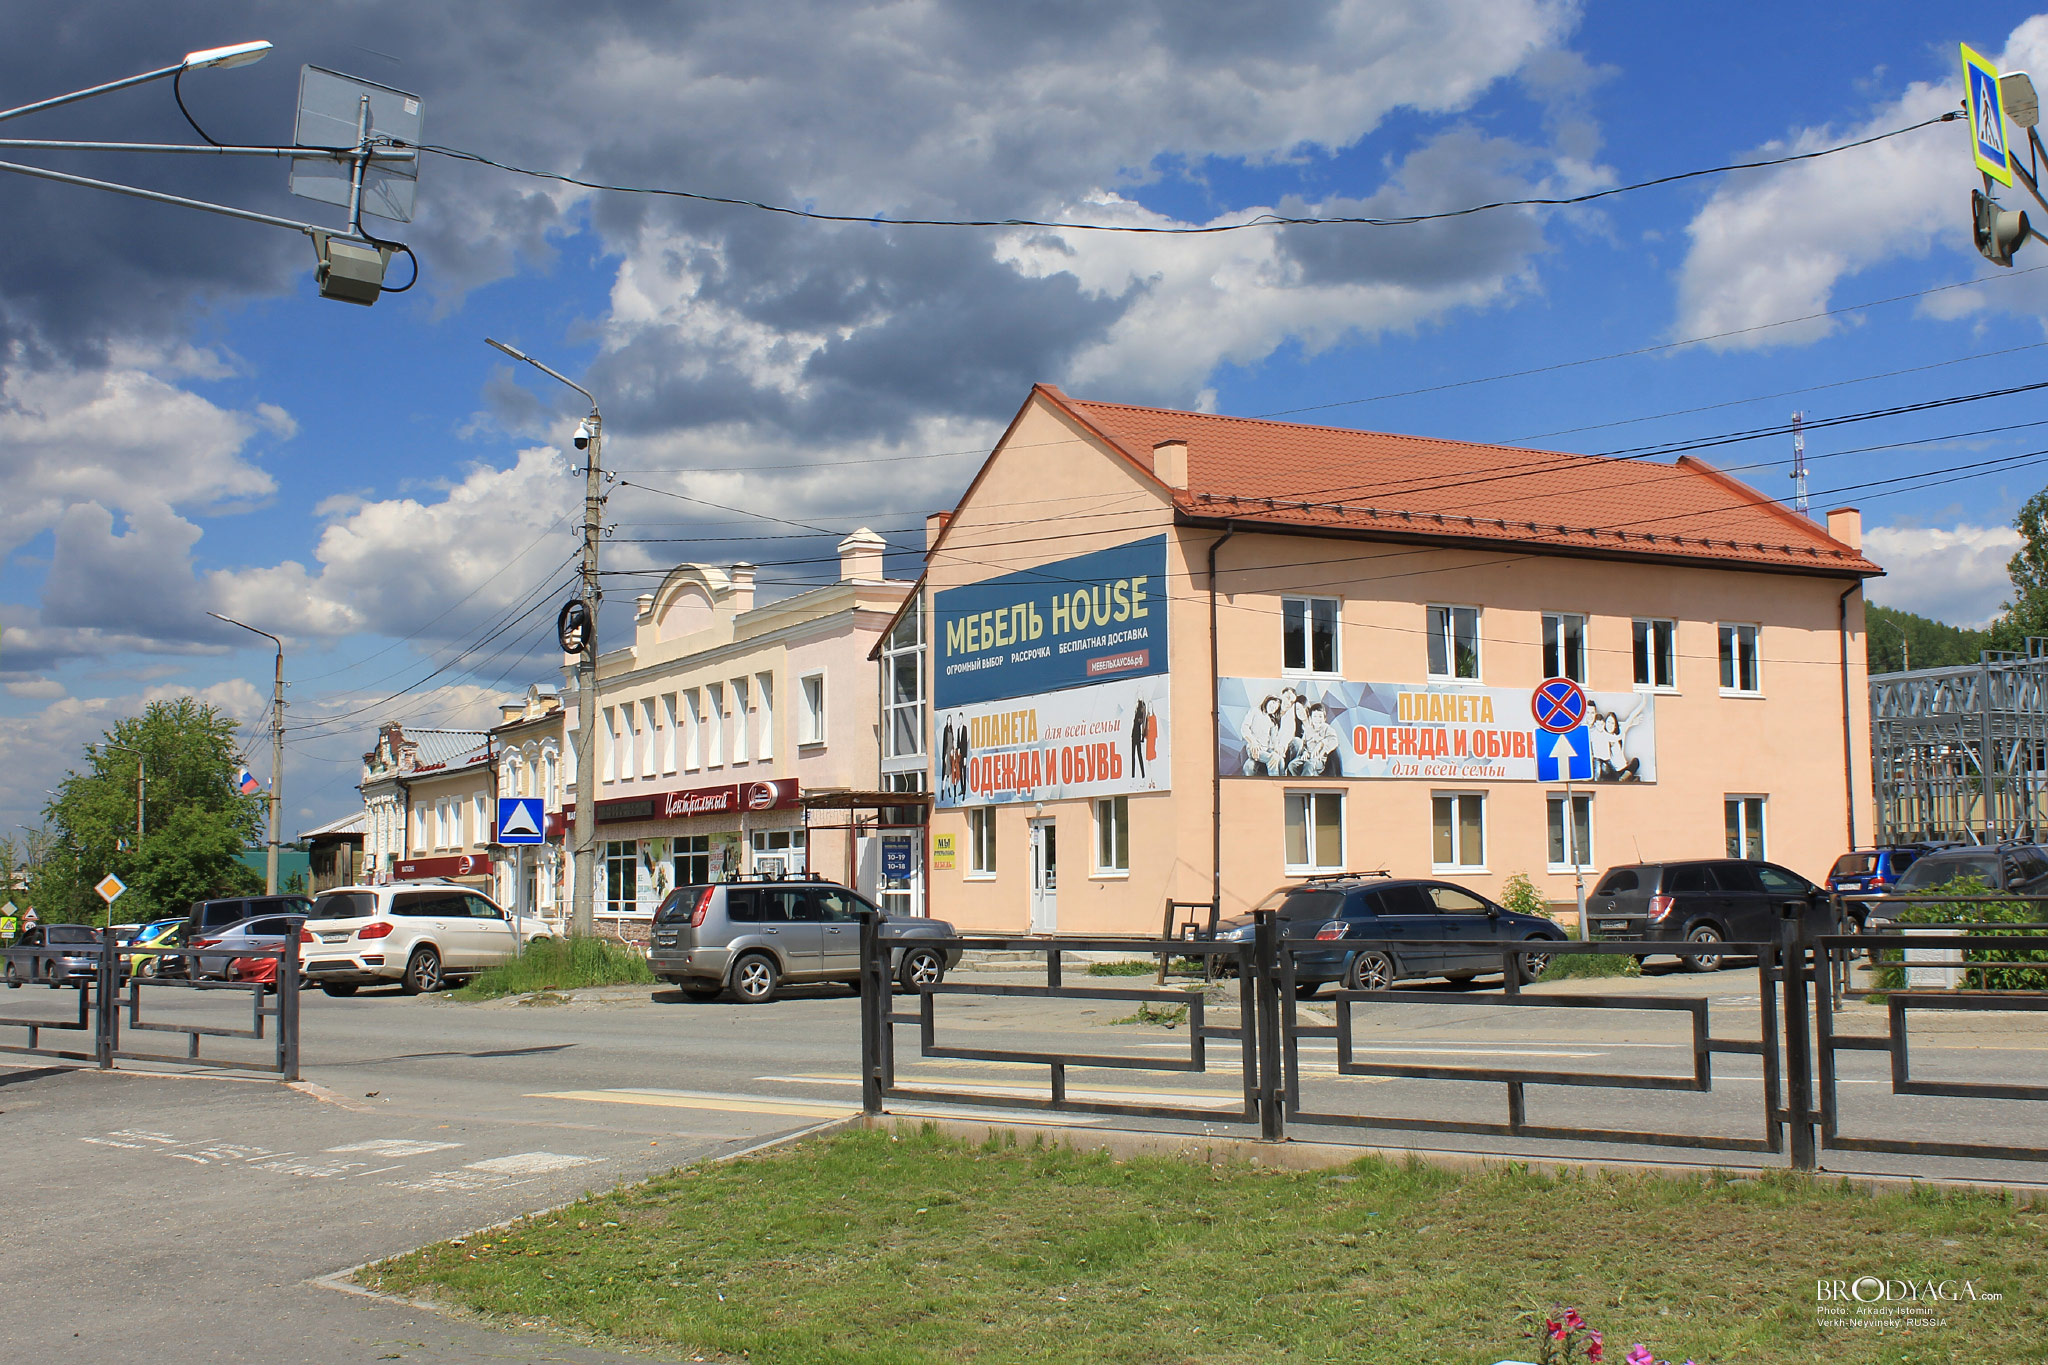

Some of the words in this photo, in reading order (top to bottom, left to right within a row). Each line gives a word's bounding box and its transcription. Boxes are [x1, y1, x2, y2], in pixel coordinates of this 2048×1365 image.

[946, 600, 1044, 657] МЕБЕЛЬ
[1052, 575, 1149, 635] HOUSE
[1059, 635, 1106, 654] БЕСПЛАТНАЯ
[1107, 627, 1149, 647] ДОСТАВКА
[946, 657, 981, 676] ОГРОМНЫЙ
[982, 655, 1004, 670] ВЫБОР
[1011, 646, 1051, 663] РАССРОЧКА
[1091, 654, 1144, 672] МЕБЕЛЬХАУС66.рф
[1398, 693, 1495, 723] ПЛАНЕТА
[970, 708, 1038, 749] ПЛАНЕТА
[1044, 723, 1062, 741] для
[1064, 719, 1087, 737] всей
[1089, 718, 1121, 735] семьи
[1353, 726, 1449, 760] ОДЕЖДА
[1453, 729, 1467, 756] И
[970, 750, 1042, 797] ОДЕЖДА
[1045, 748, 1058, 787] И
[1062, 742, 1122, 784] ОБУВЬ
[1392, 760, 1419, 776] для
[1424, 761, 1457, 776] всей
[1462, 765, 1506, 777] семьи
[665, 791, 733, 817] Центральный
